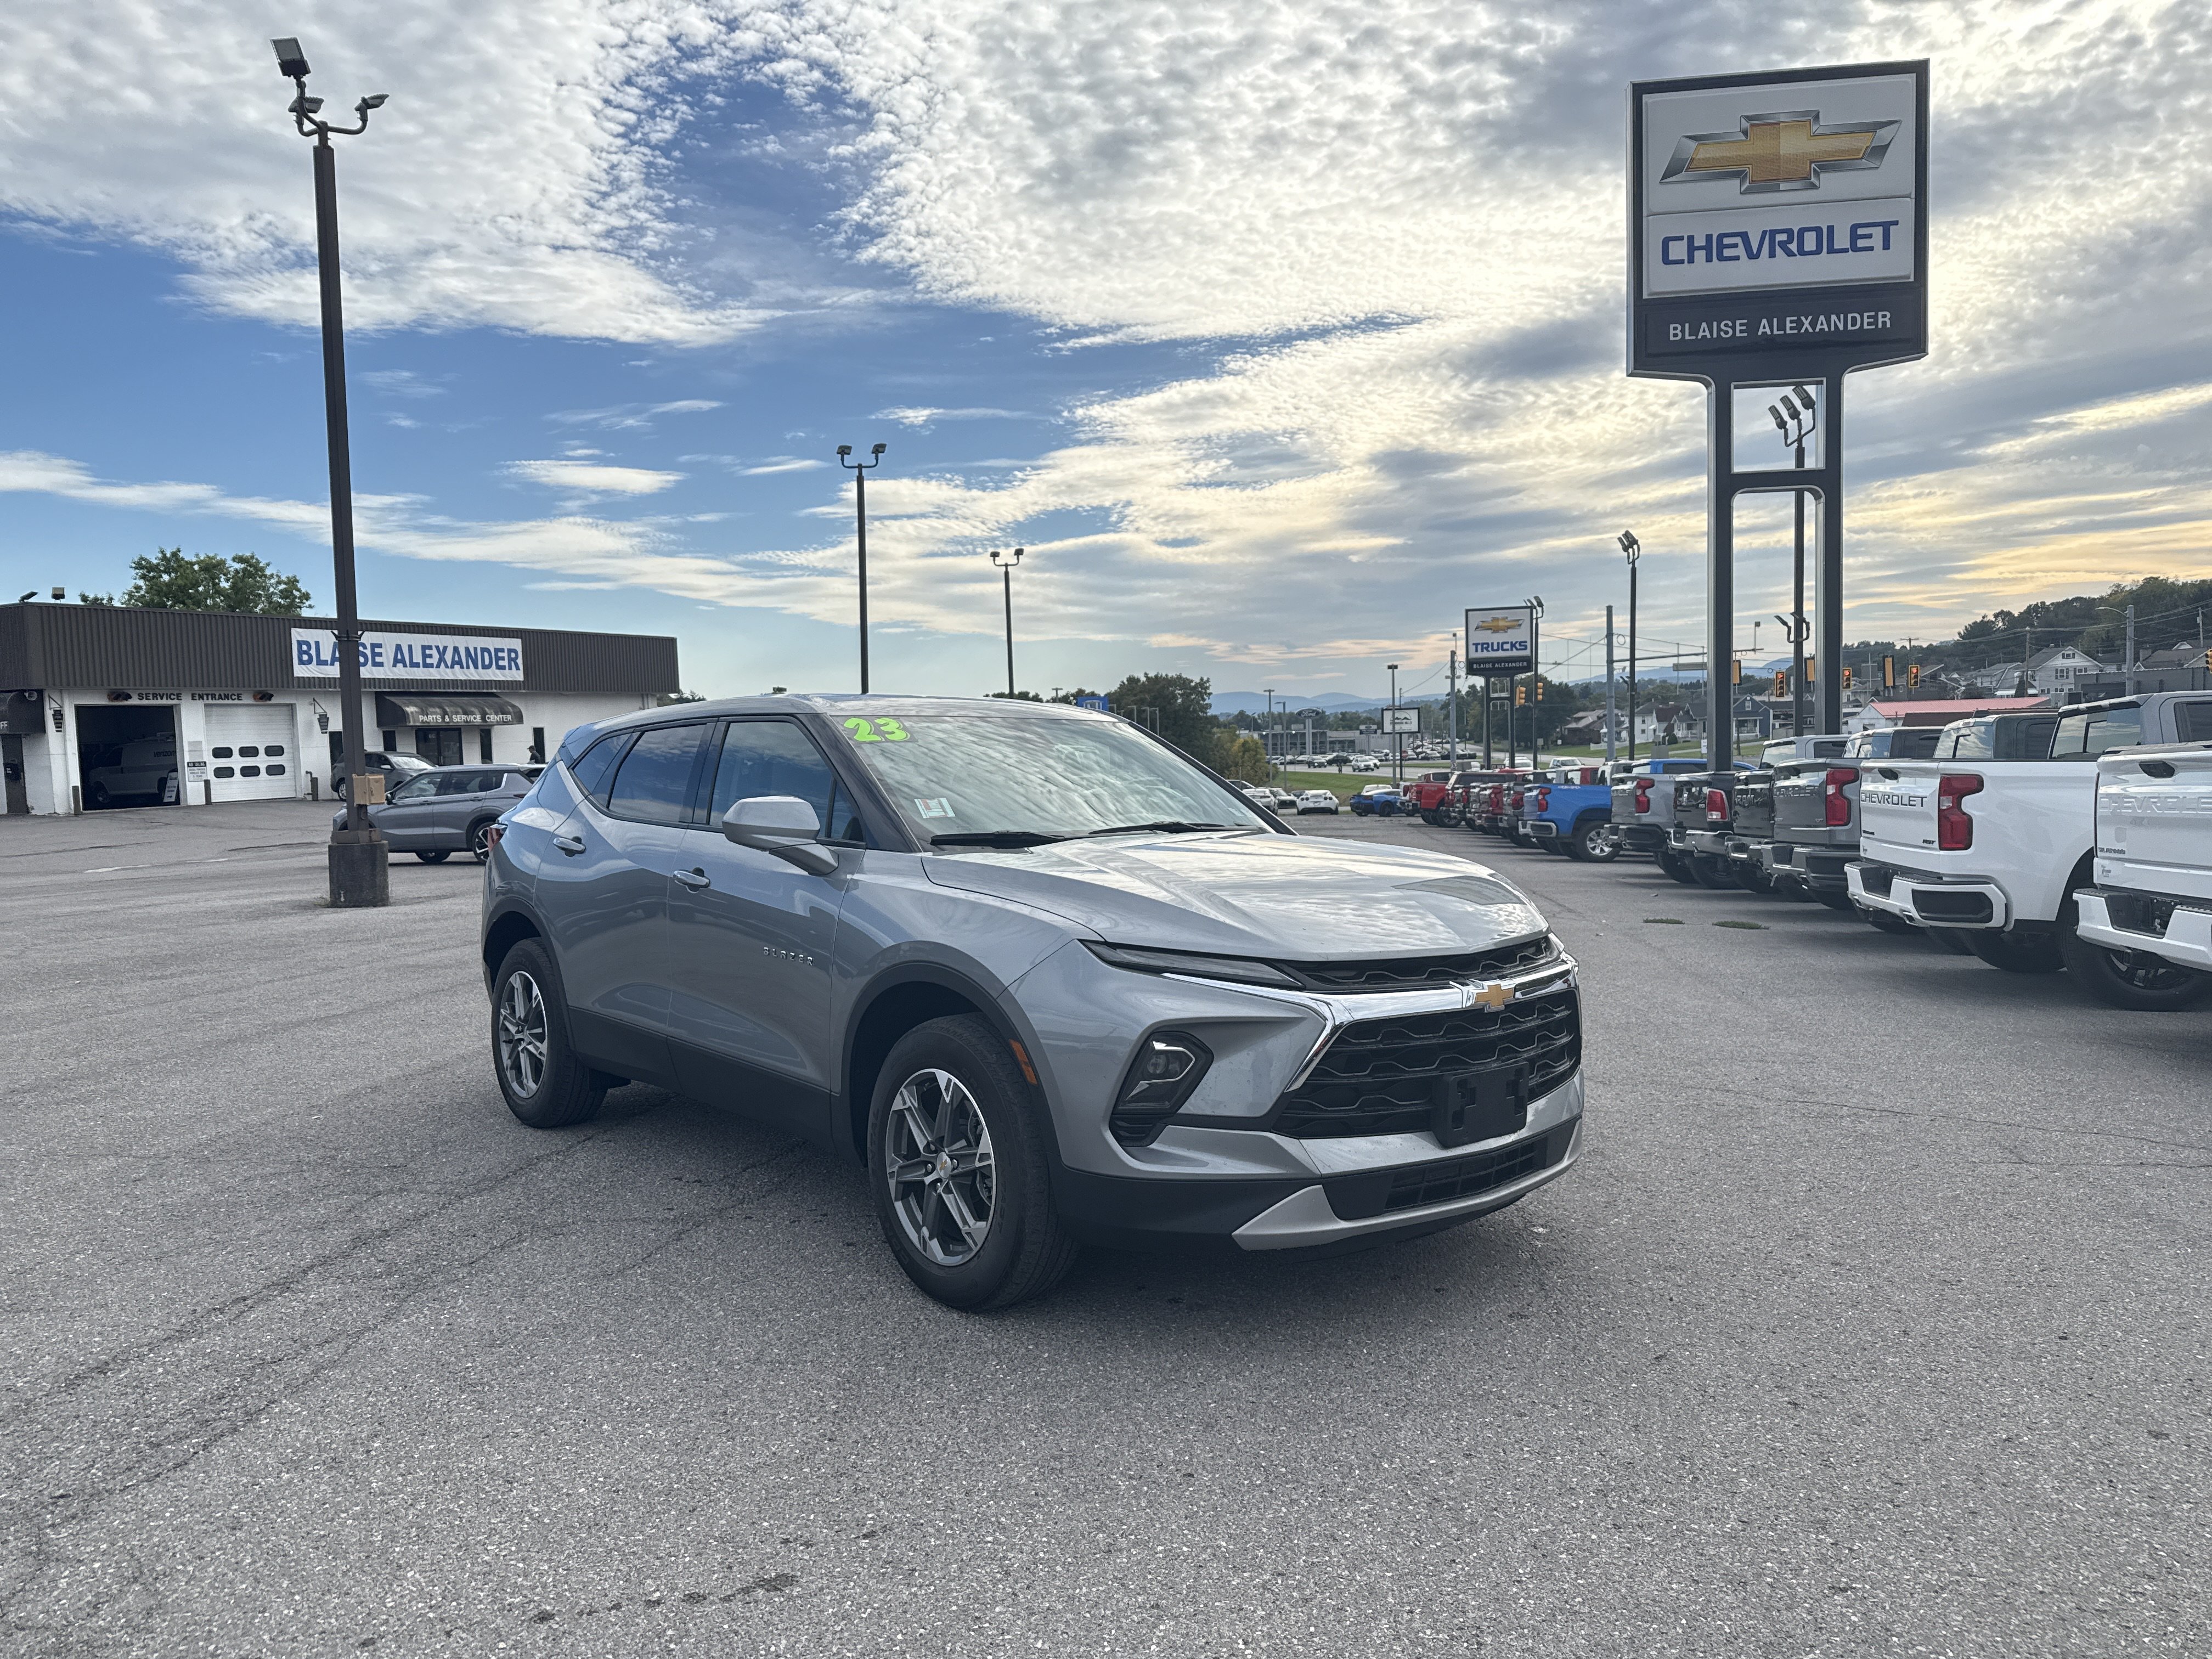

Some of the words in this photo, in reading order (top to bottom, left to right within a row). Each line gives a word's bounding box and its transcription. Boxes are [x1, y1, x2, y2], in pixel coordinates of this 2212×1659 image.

[1662, 220, 1899, 265] CHEVROLET
[1669, 319, 1748, 341] BLAISE
[1757, 311, 1891, 336] ALEXANDER
[297, 640, 384, 667] BLASE
[392, 644, 521, 671] ALEXANDER
[1472, 640, 1528, 652] TRUCKS
[137, 692, 183, 701] SERVICE
[191, 693, 243, 701] ENTRANCE
[843, 717, 911, 742] 23
[1860, 792, 1928, 808] CHEVROLET
[763, 946, 815, 966] BLAZER
